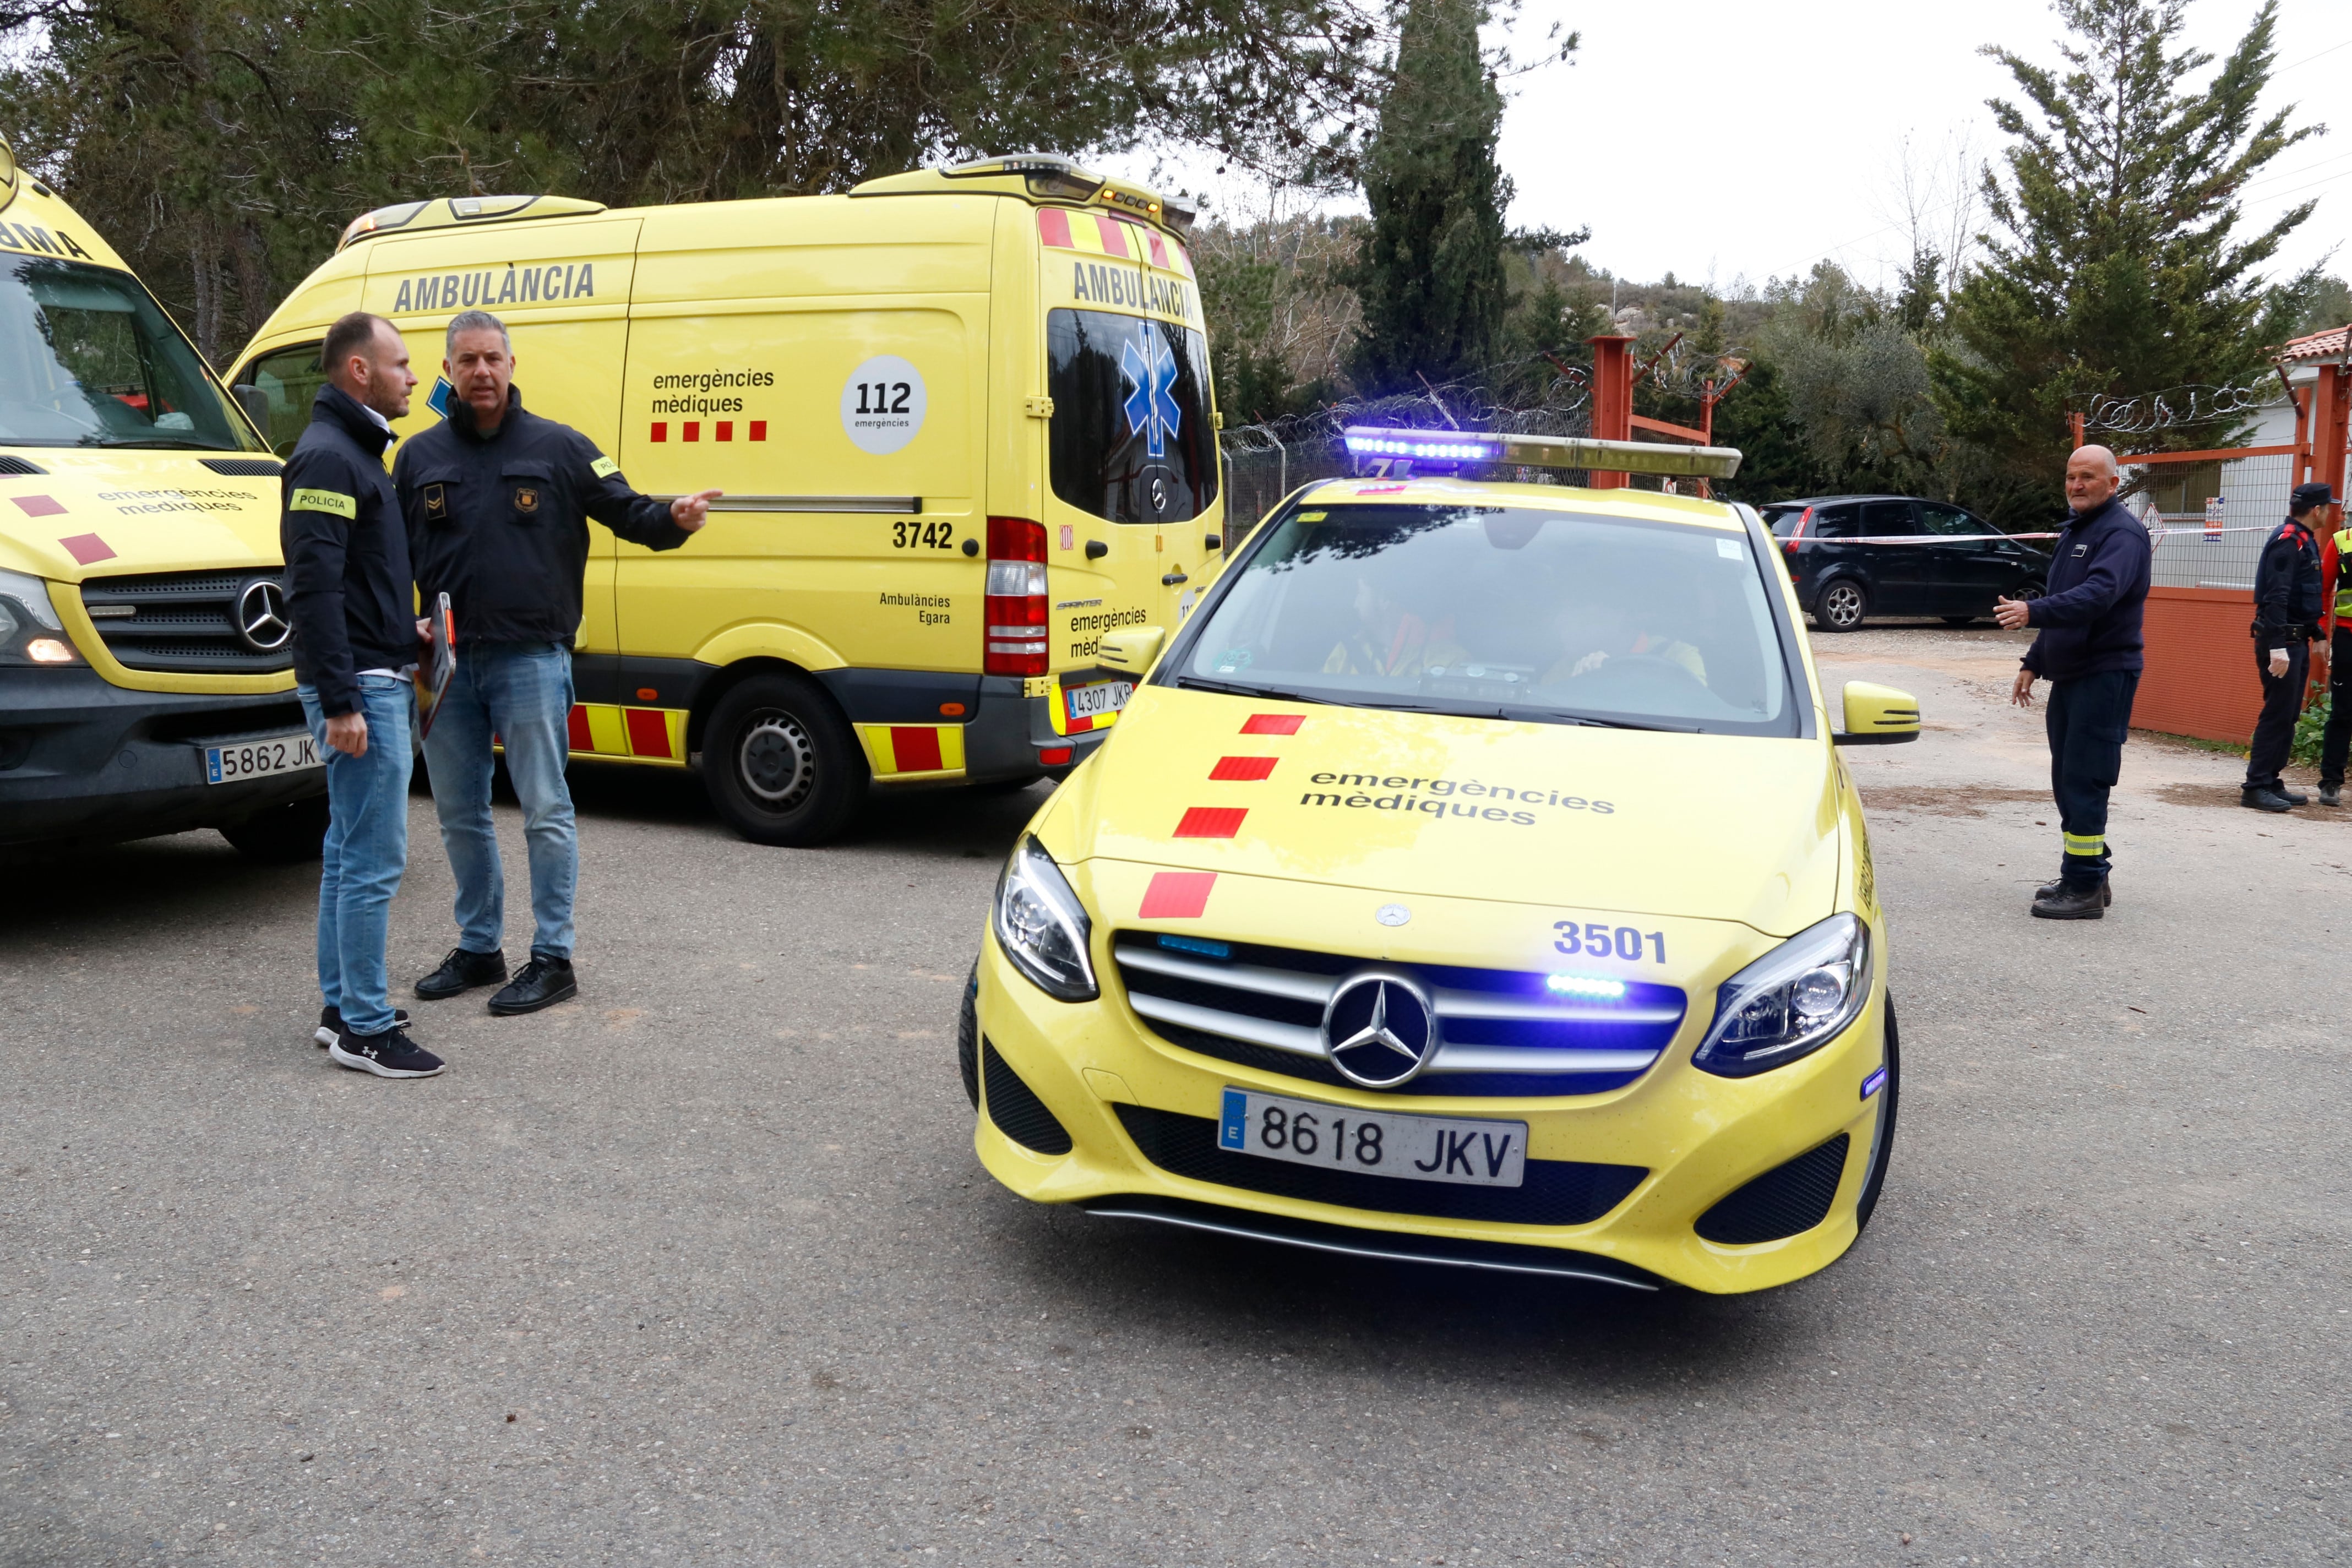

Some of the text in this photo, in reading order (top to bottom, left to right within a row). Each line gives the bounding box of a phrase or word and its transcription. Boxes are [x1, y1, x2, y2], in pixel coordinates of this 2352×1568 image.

[394, 263, 594, 312] AMBULÀNCIA
[1074, 262, 1194, 320] AMBULÀNCIA
[654, 369, 774, 393] emergències
[652, 395, 743, 417] mèdiques
[856, 383, 911, 413] 112
[855, 420, 909, 429] emergències
[600, 461, 615, 470] PO
[98, 487, 258, 501] emergències
[117, 498, 243, 515] mèdiques
[300, 495, 345, 510] POLICIA
[893, 522, 952, 548] 3742
[880, 593, 950, 608] Ambulàncies
[1056, 598, 1102, 610] SPRINTER
[1182, 604, 1193, 618] 11
[919, 611, 950, 626] Egara
[1071, 606, 1146, 633] emergències
[1077, 688, 1106, 712] 4307
[1112, 684, 1131, 706] JKR
[223, 743, 286, 775] 5862
[1310, 771, 1615, 815] emergències
[1300, 790, 1536, 826] mèdiques
[1554, 921, 1666, 964] 3501
[1228, 1106, 1511, 1178] E 8618 JKV
